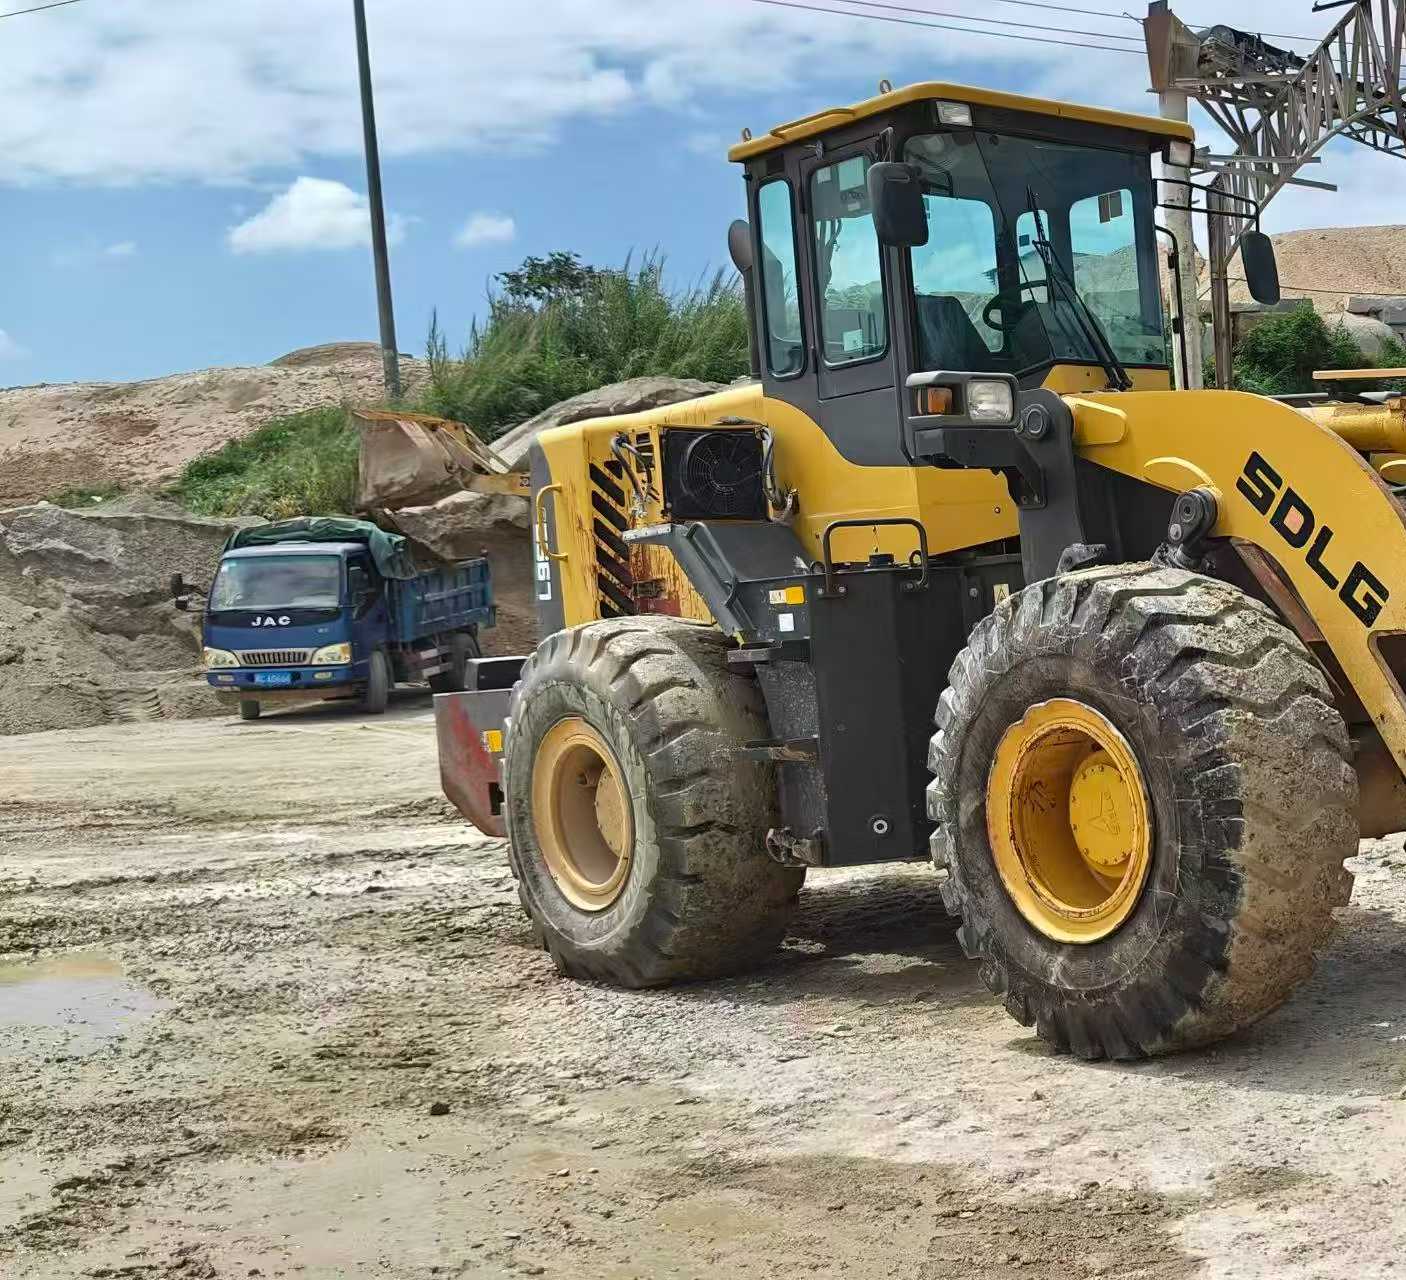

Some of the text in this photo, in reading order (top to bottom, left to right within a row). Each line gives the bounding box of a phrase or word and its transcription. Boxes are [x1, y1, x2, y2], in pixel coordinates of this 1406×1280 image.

[535, 506, 552, 601] L95
[1236, 450, 1390, 628] SDLG
[251, 615, 292, 627] JAC
